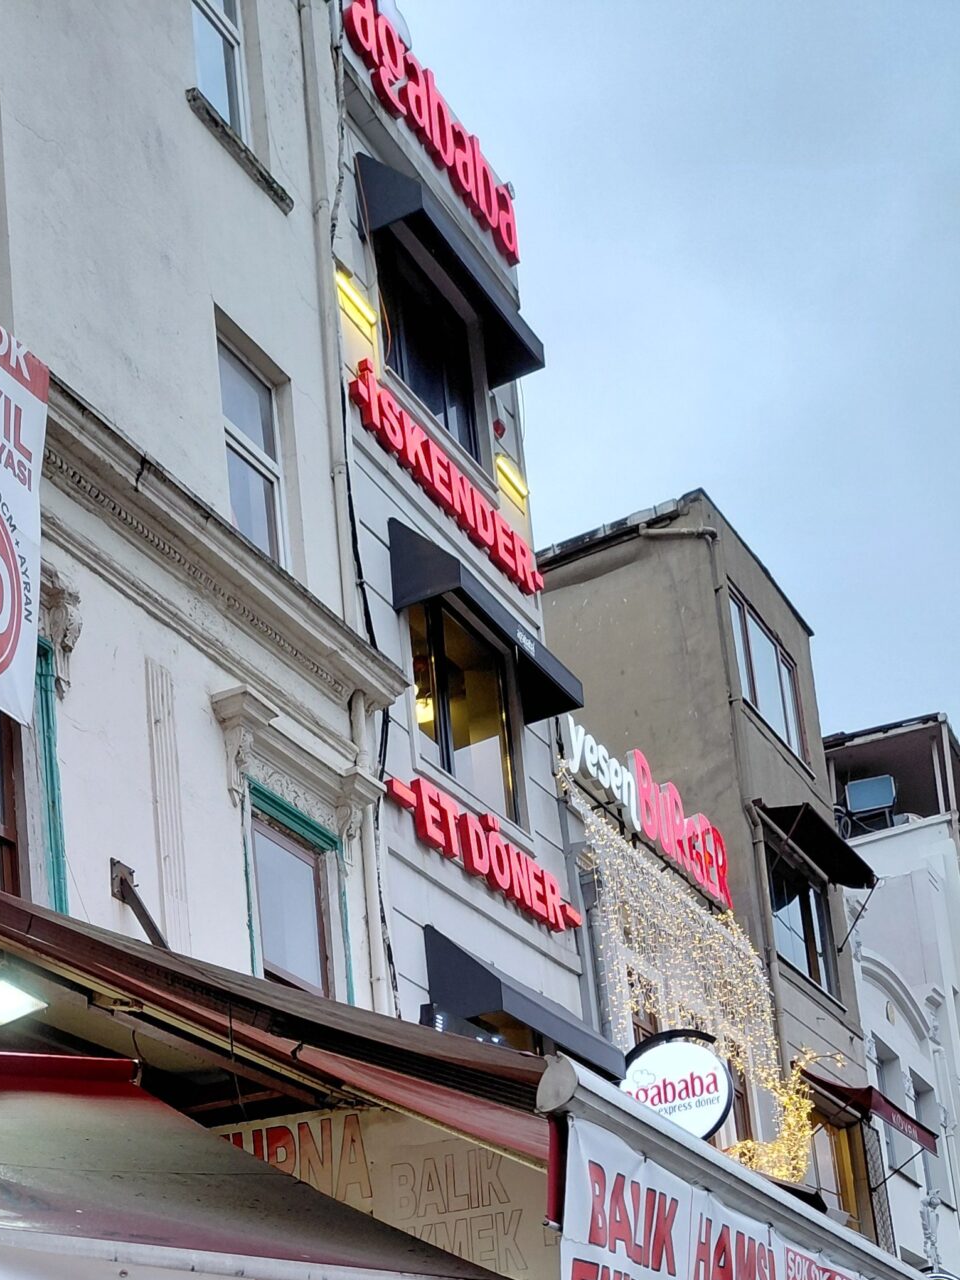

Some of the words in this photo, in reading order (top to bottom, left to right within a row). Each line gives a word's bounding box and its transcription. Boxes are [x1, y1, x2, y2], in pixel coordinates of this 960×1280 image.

[17, 554, 33, 623] AYRAN
[391, 1150, 511, 1220] BALIK
[587, 1159, 679, 1277] BALIK
